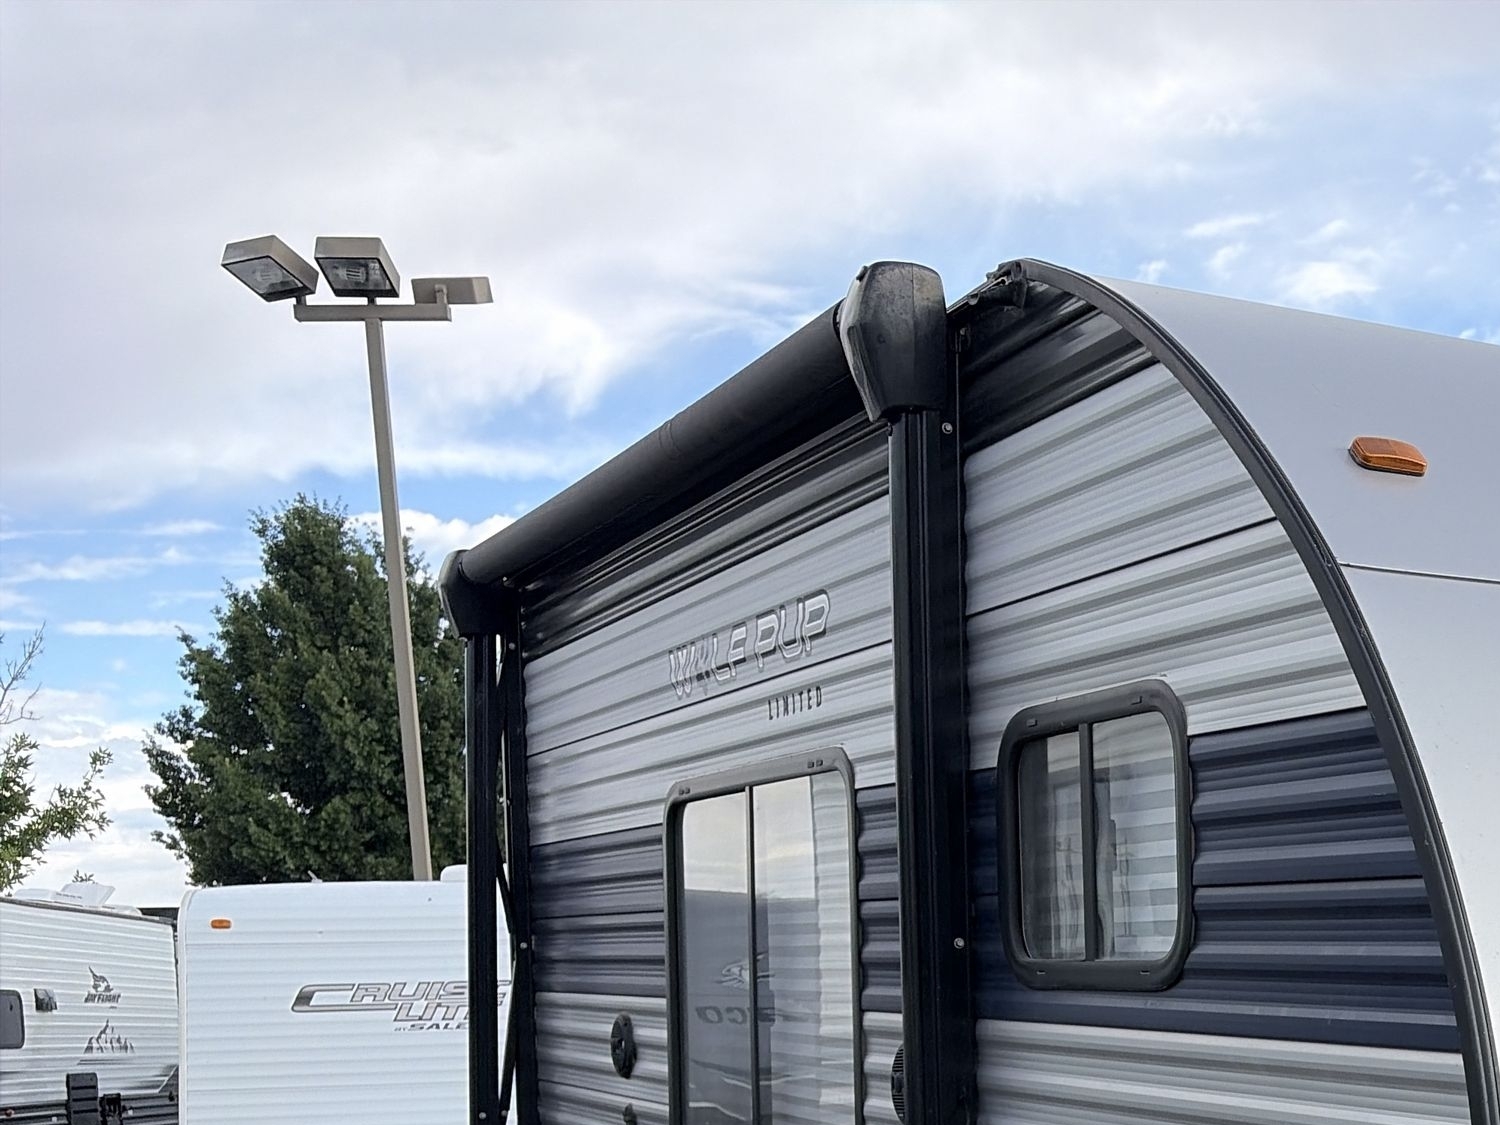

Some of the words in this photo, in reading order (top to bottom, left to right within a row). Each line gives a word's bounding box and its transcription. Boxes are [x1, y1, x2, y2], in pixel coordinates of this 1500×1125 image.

[754, 589, 830, 671] PUP
[767, 685, 823, 720] LIMITED
[393, 1001, 469, 1021] LIT
